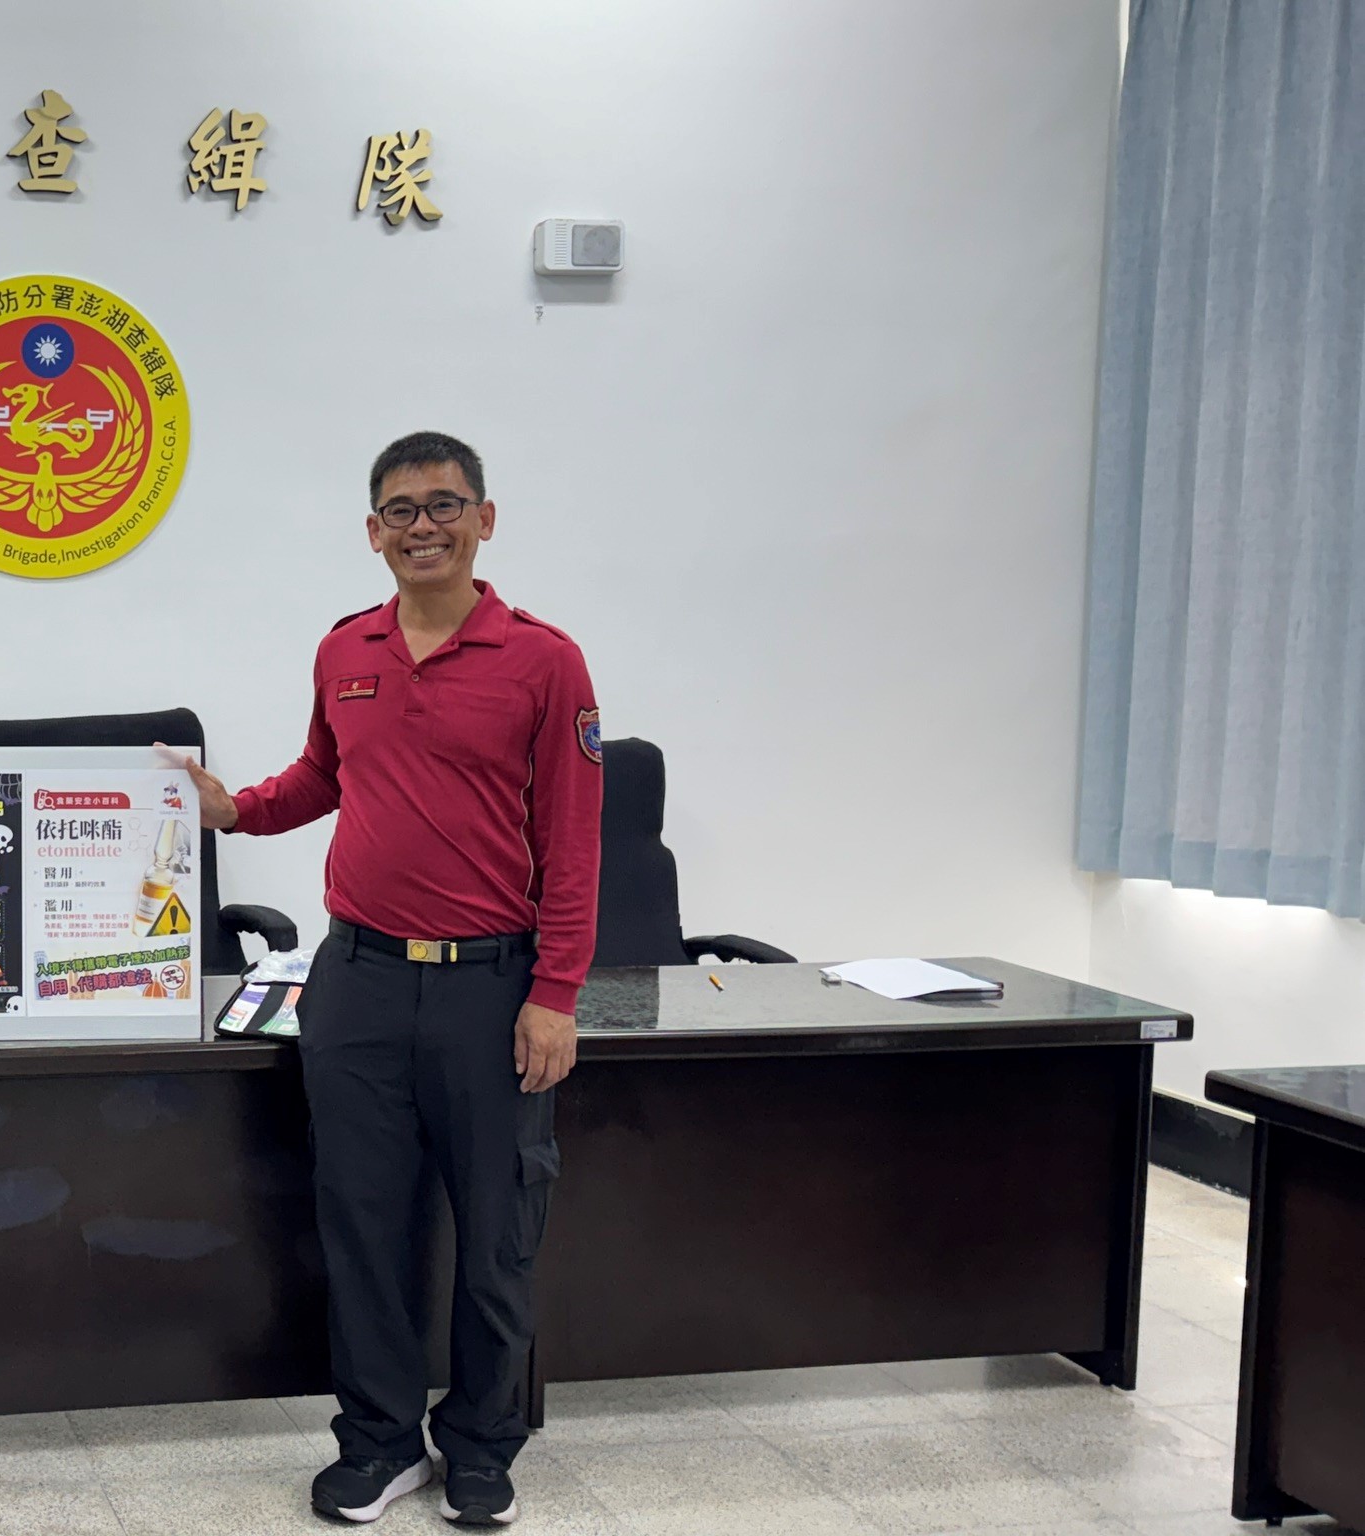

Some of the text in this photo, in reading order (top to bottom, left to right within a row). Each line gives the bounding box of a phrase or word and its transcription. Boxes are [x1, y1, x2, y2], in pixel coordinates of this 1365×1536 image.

[56, 796, 119, 806] 食藥安全小百科
[35, 818, 123, 841] 依托咪酯
[37, 842, 123, 858] etomidate
[38, 968, 153, 998] 自用、代購都違法
